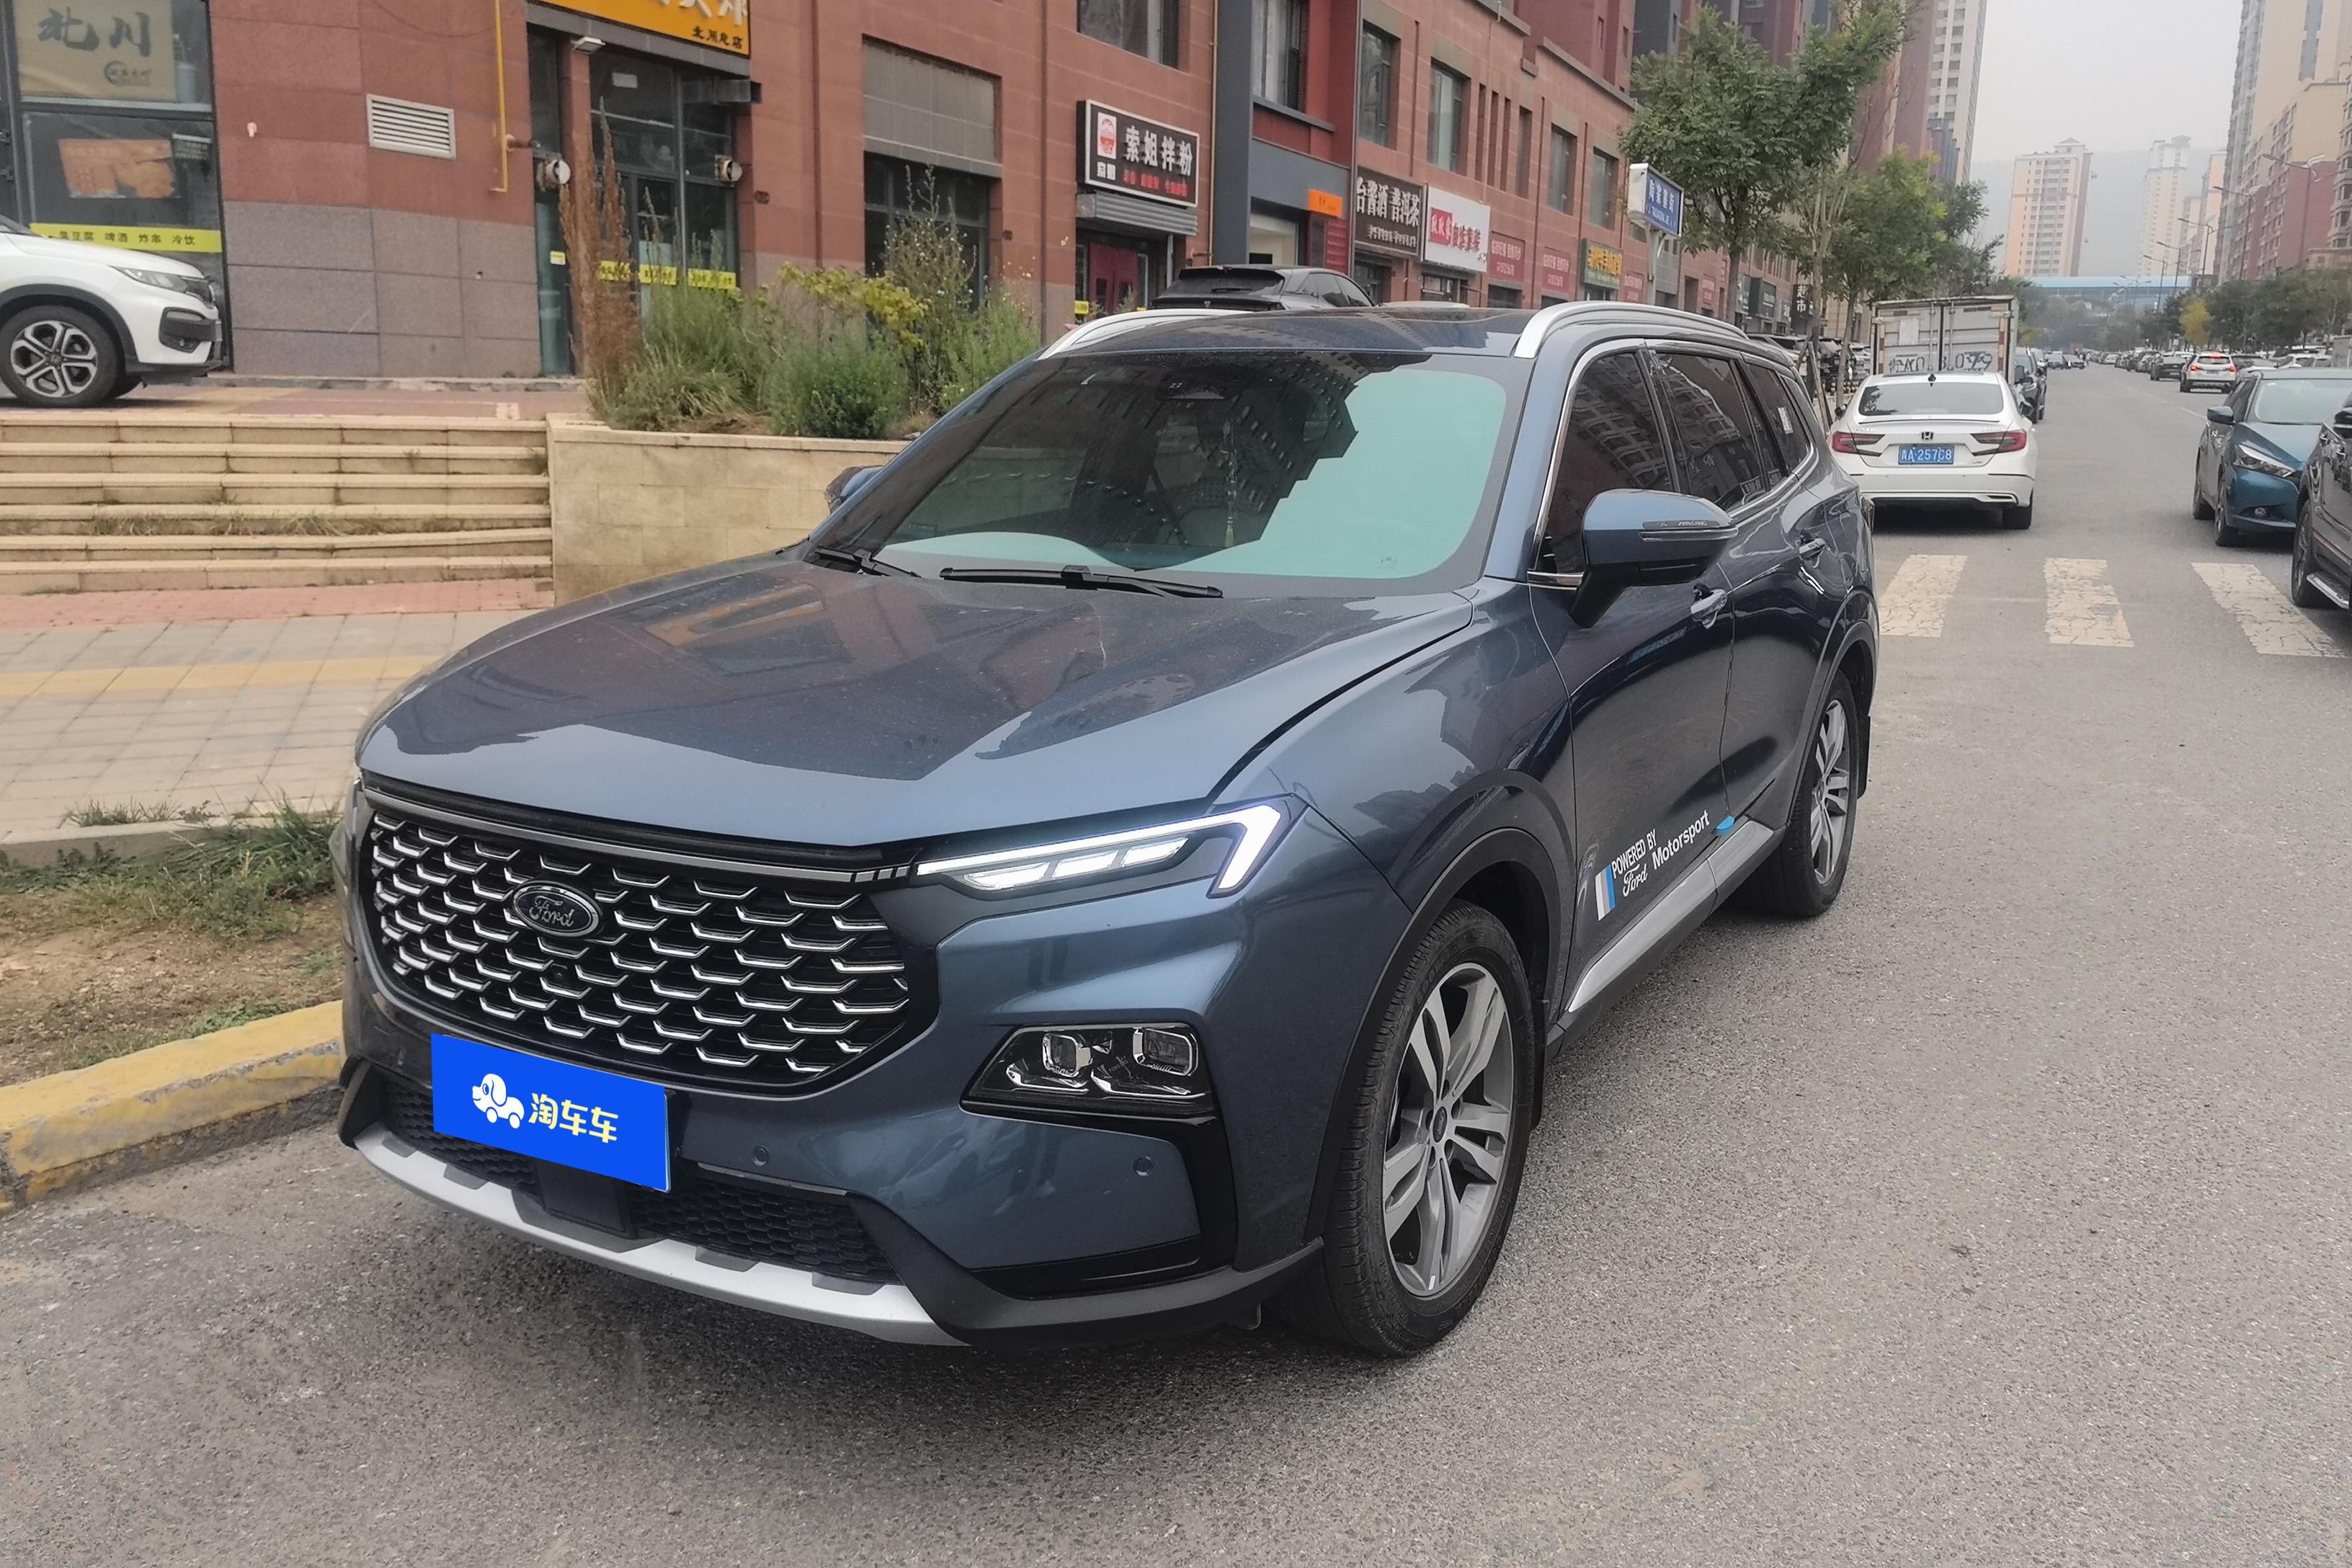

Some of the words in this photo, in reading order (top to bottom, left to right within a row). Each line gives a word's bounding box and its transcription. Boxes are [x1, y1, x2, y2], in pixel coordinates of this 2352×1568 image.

[38, 6, 151, 57] 北川
[1611, 839, 1646, 878] POWERED
[1647, 829, 1657, 850] BY
[1623, 863, 1648, 896] Ford
[1652, 808, 1710, 870] Motorsport
[529, 896, 574, 927] Ford
